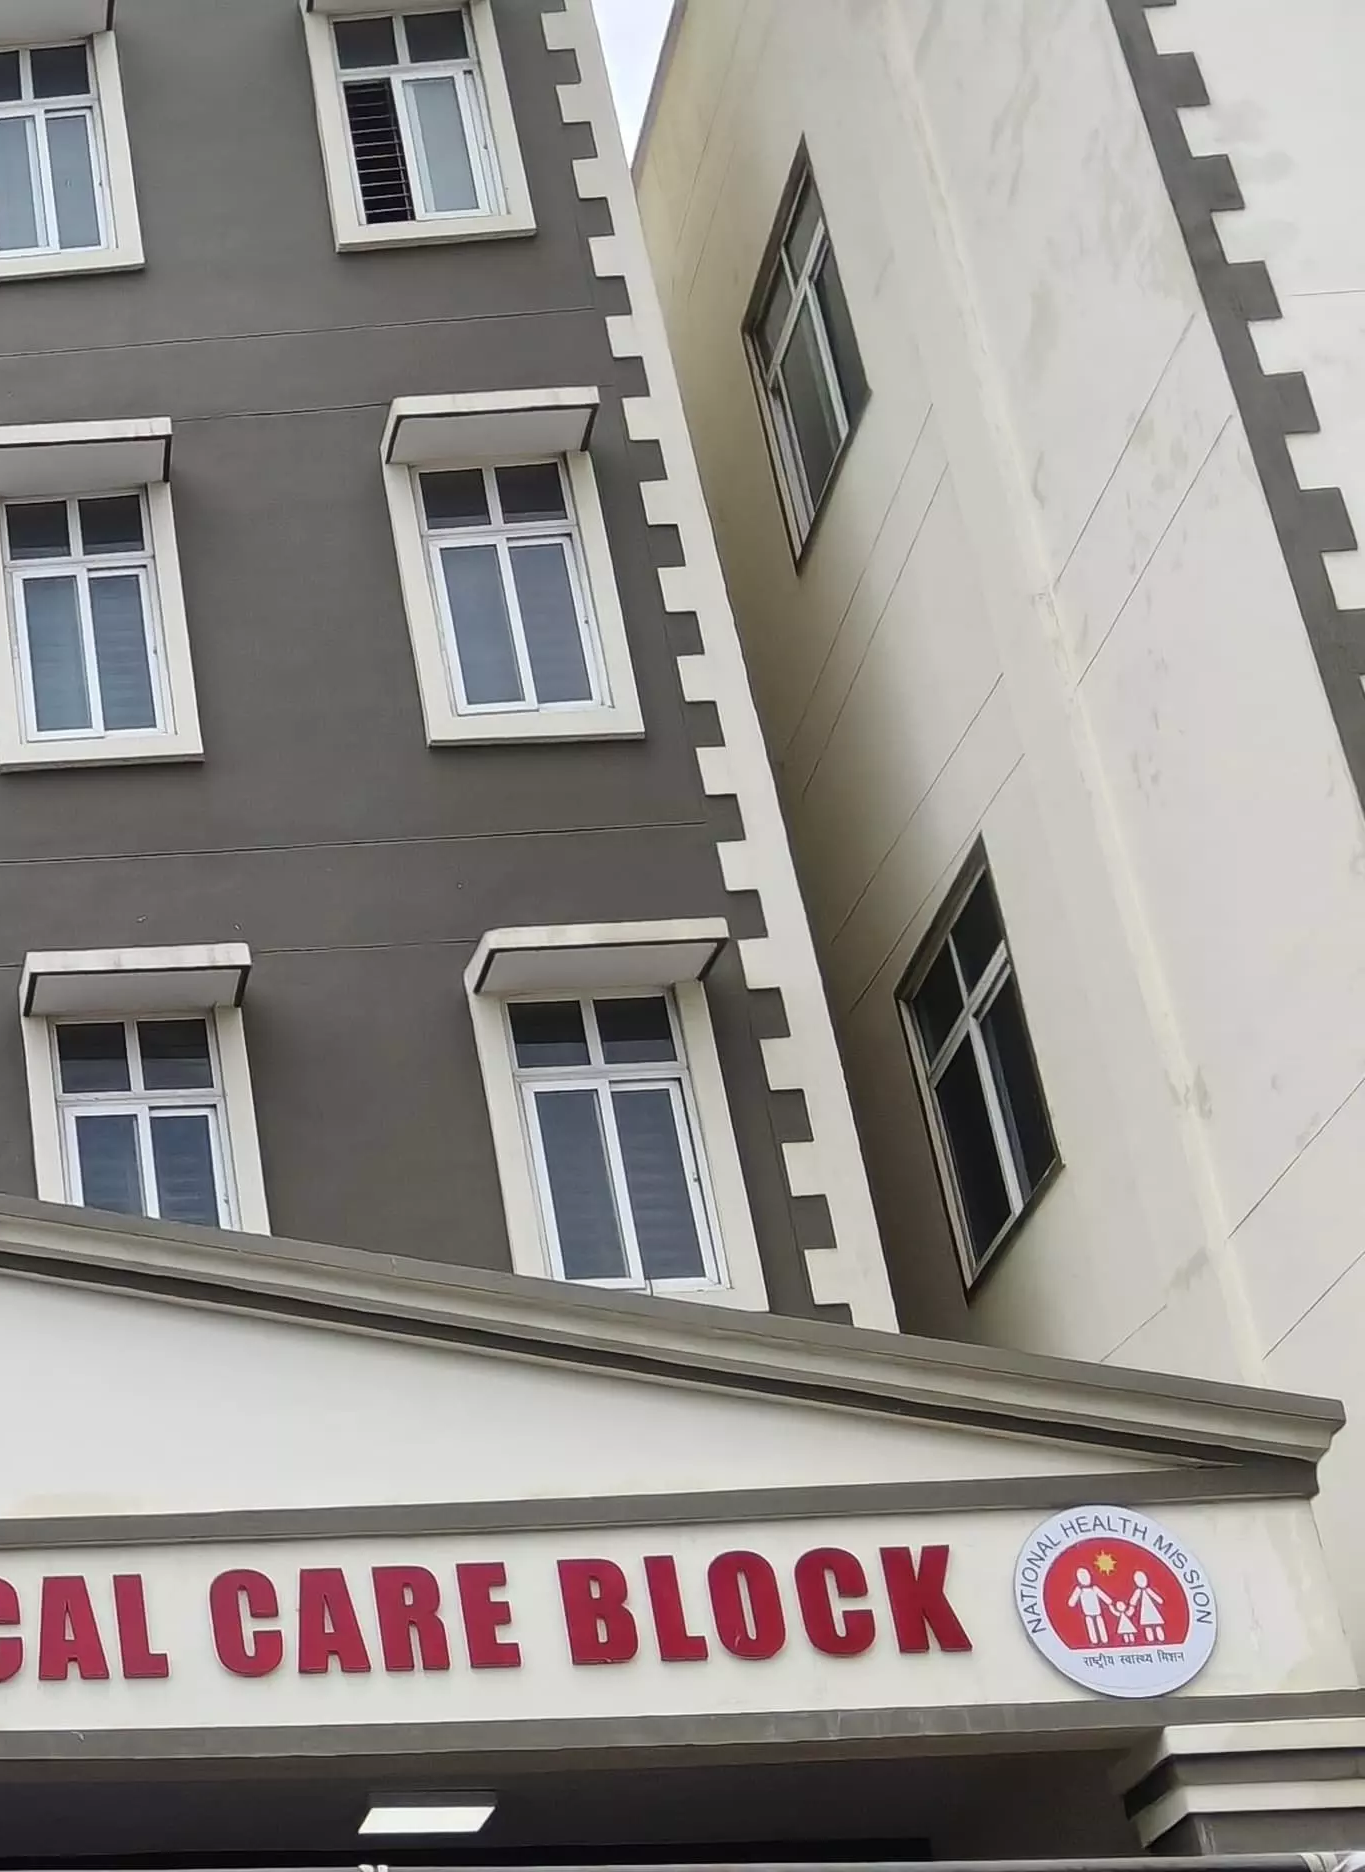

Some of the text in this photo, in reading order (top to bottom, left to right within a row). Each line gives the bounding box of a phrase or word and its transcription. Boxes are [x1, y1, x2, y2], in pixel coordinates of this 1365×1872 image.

[209, 1562, 522, 1679] CARE
[557, 1544, 973, 1666] BLOCK
[1019, 1514, 1214, 1634] NATIONAL HEALTH MISSION
[1082, 1652, 1115, 1669] राष्ट्रीय
[1157, 1649, 1185, 1664] मिशन
